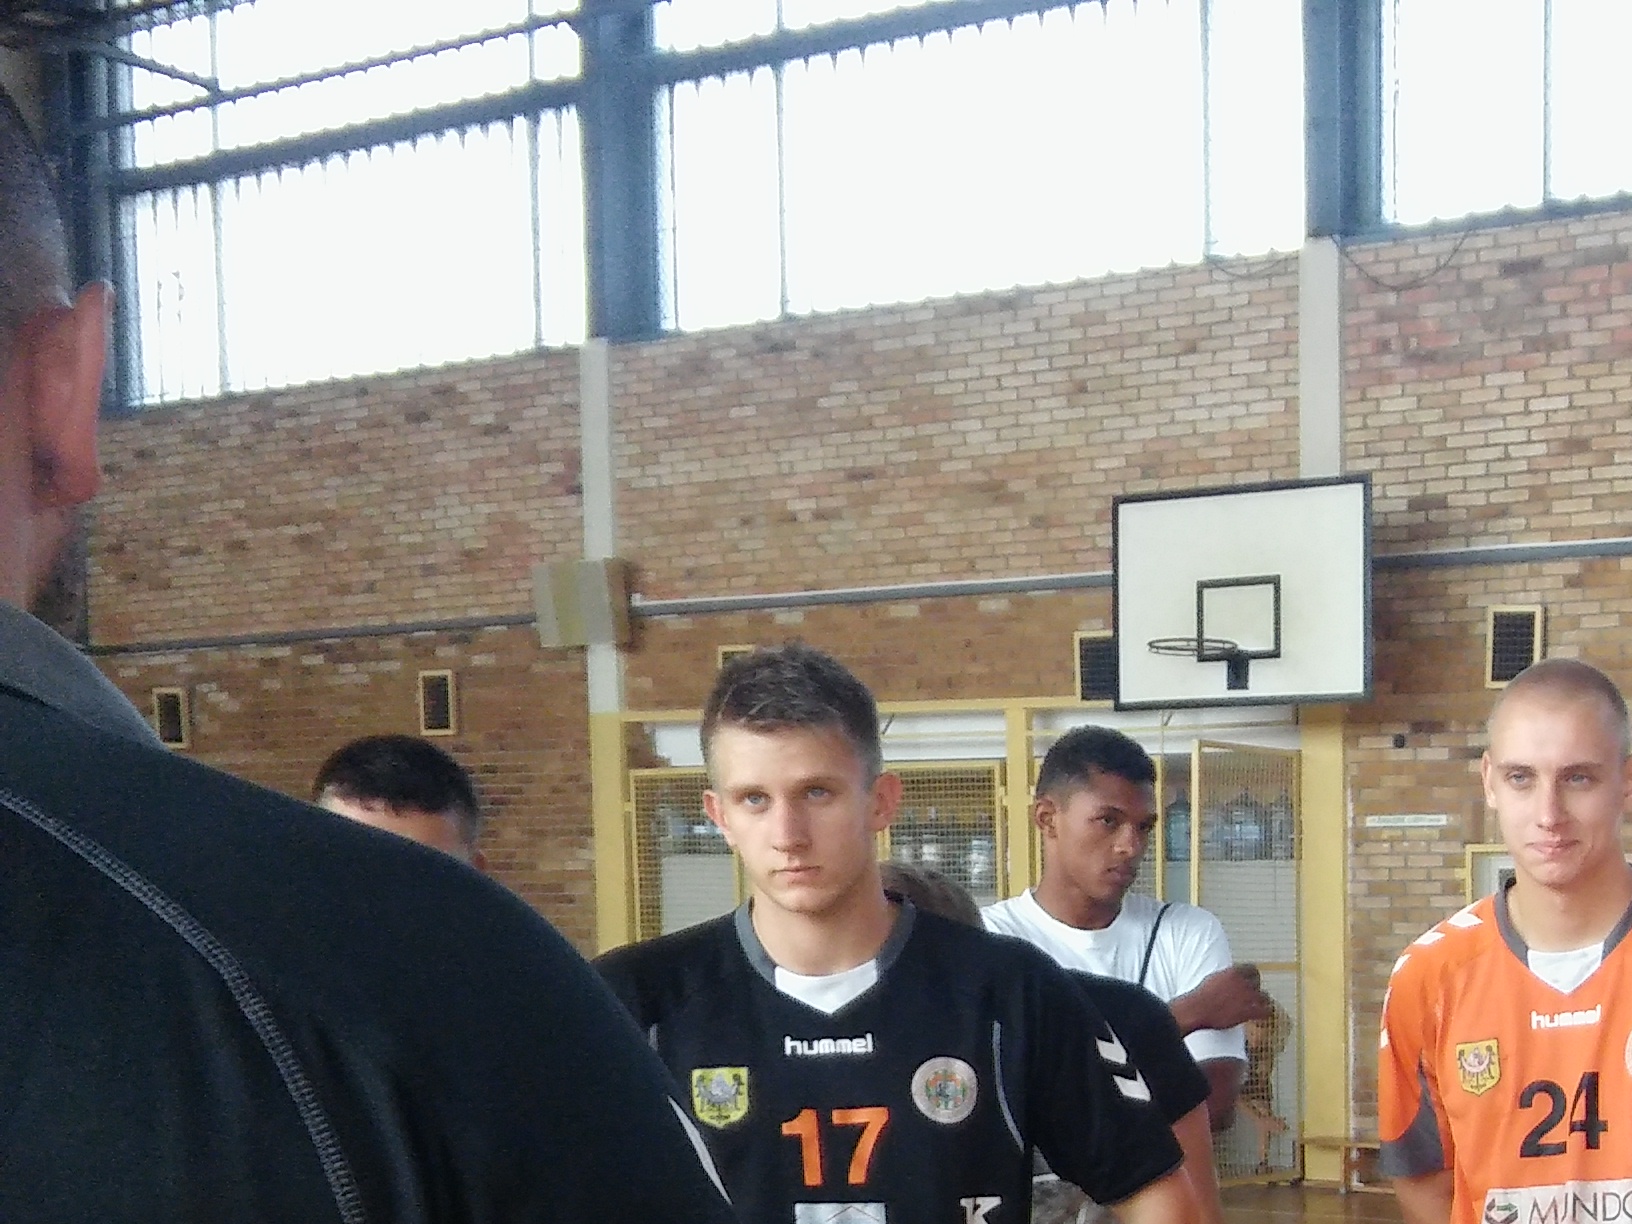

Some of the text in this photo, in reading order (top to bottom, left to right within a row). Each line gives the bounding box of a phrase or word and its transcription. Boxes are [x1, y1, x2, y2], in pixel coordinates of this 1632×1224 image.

[784, 1032, 874, 1056] hummel
[781, 1106, 890, 1187] 17
[1519, 1071, 1608, 1158] 24
